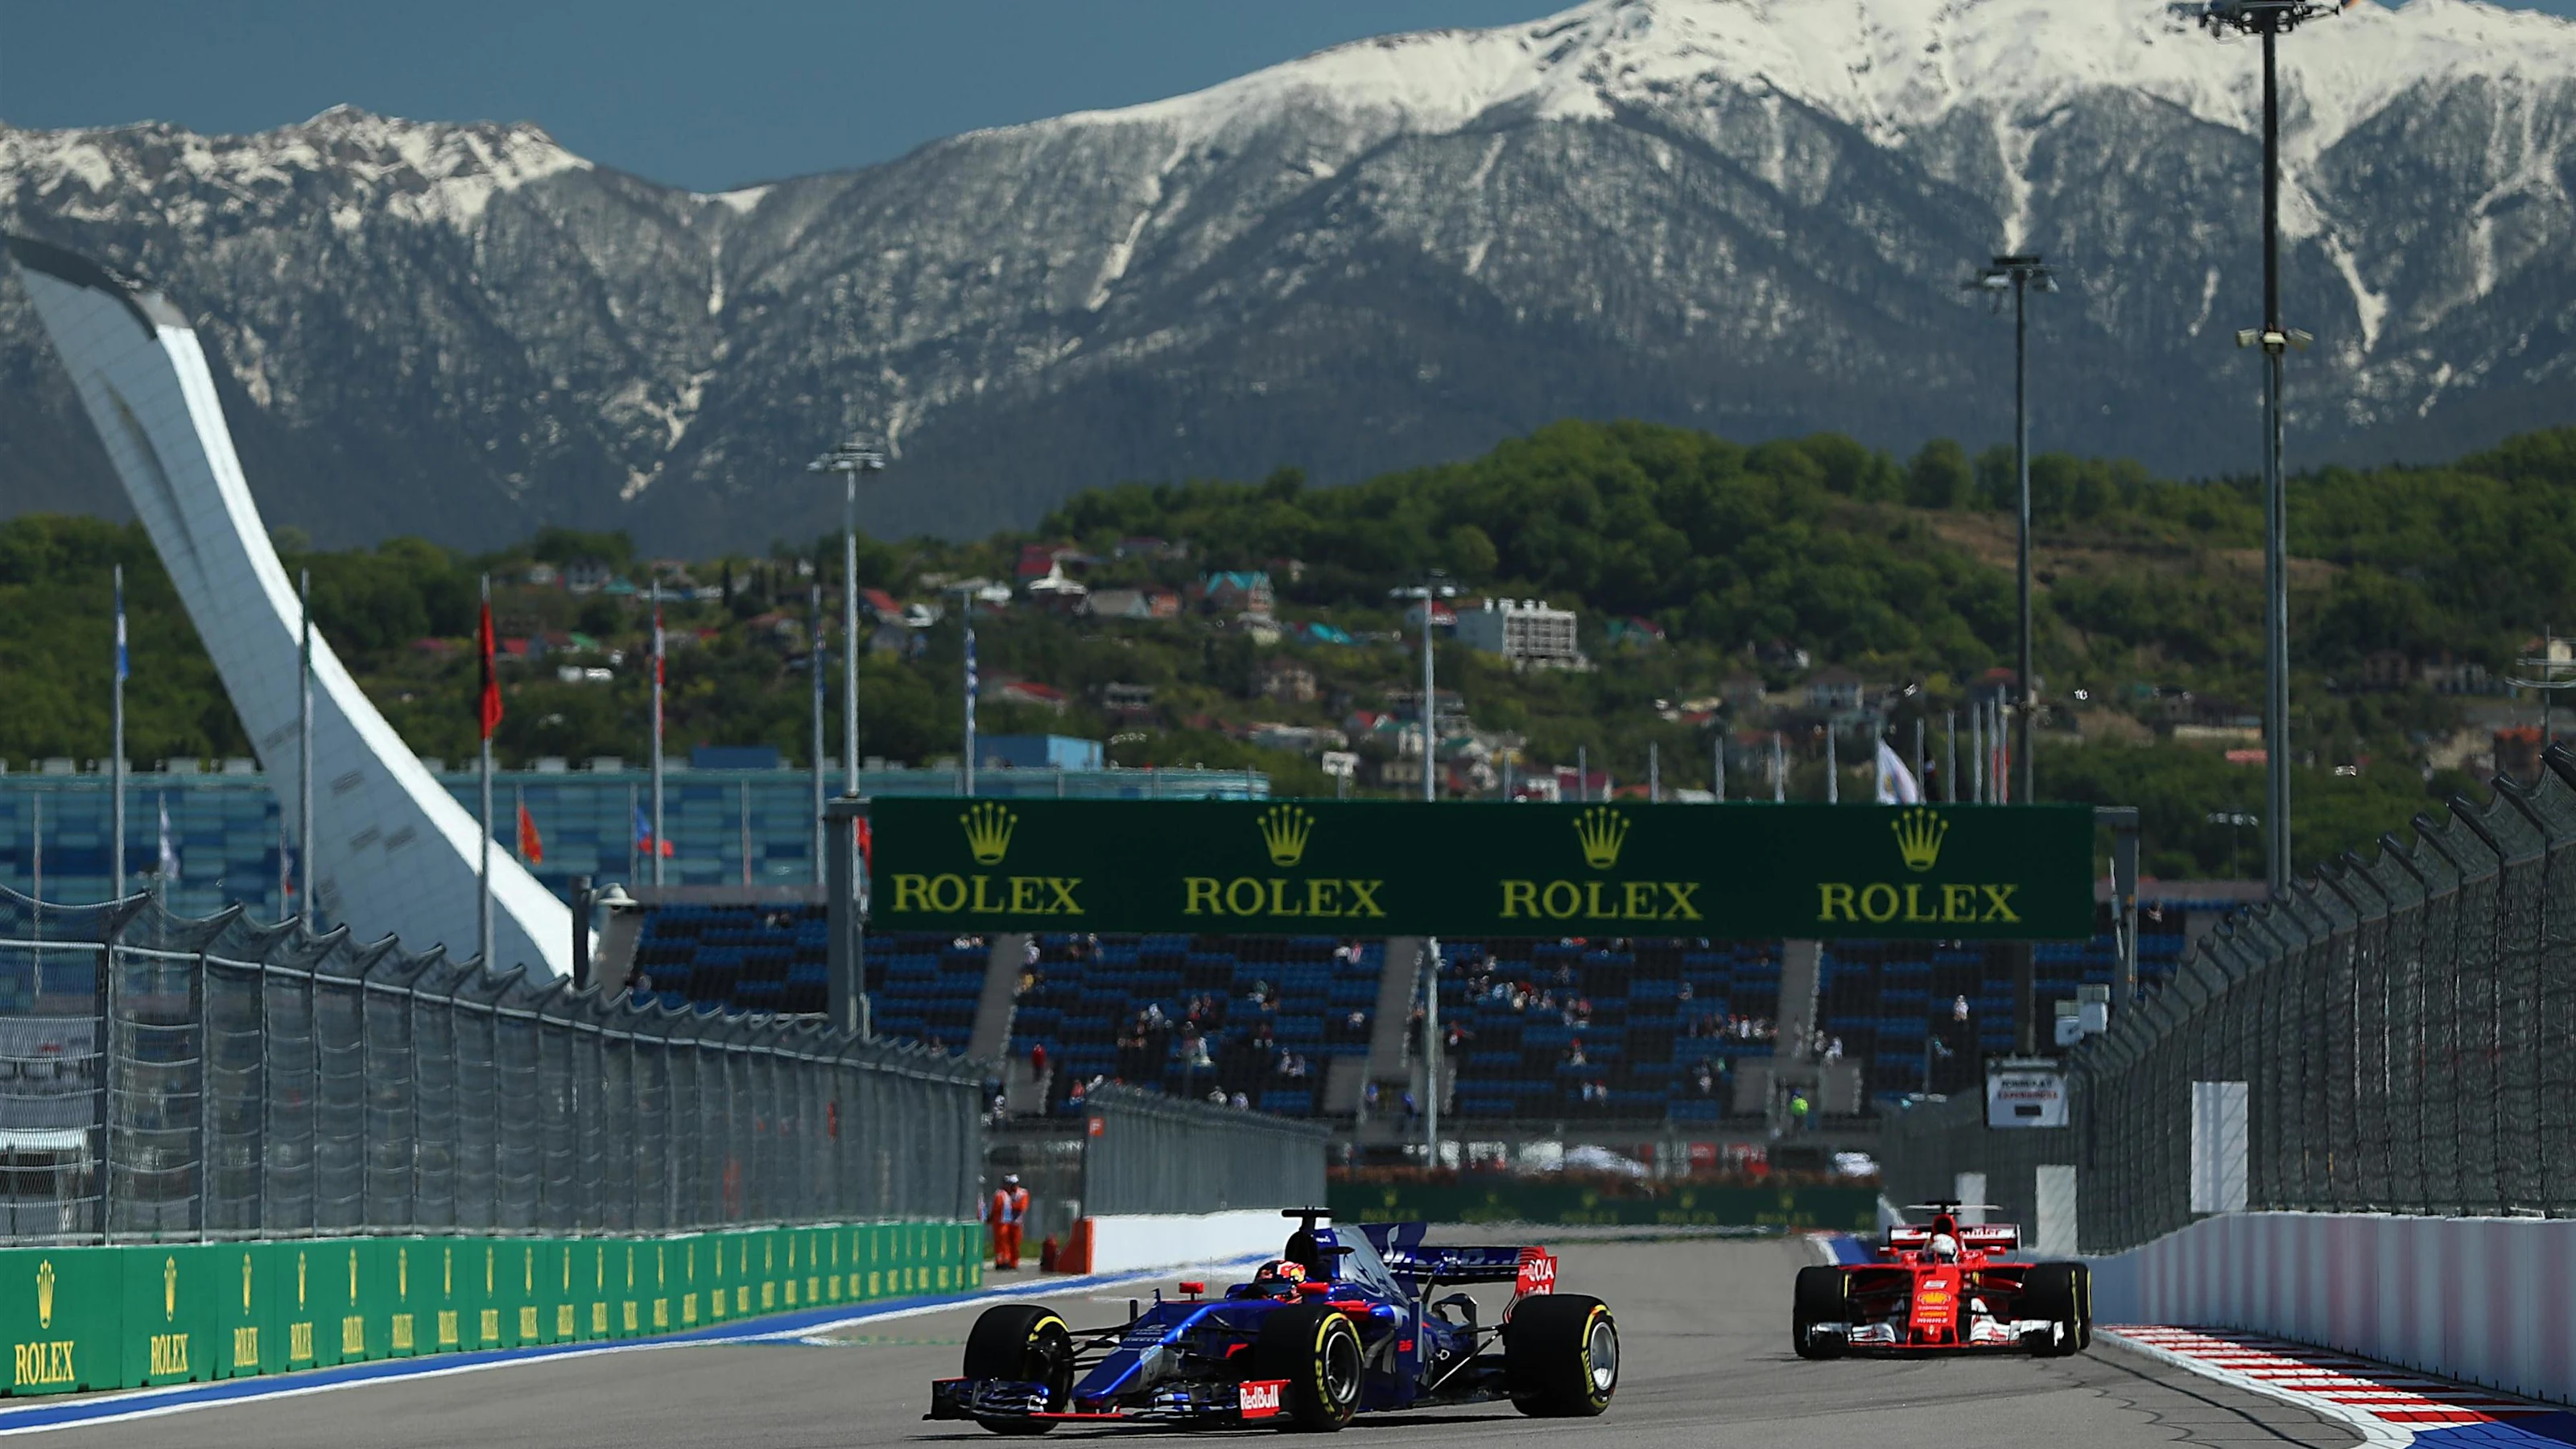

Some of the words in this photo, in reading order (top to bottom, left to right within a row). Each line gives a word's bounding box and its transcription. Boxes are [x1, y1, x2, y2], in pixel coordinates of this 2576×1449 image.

[891, 873, 1085, 915] ROLEX
[1183, 877, 1386, 917] ROLEX
[1499, 880, 1703, 920] ROLEX
[1818, 883, 2021, 923] ROLEX
[14, 1340, 75, 1385] ROLEX
[151, 1333, 189, 1375] ROLEX
[1398, 1340, 1413, 1352] 26
